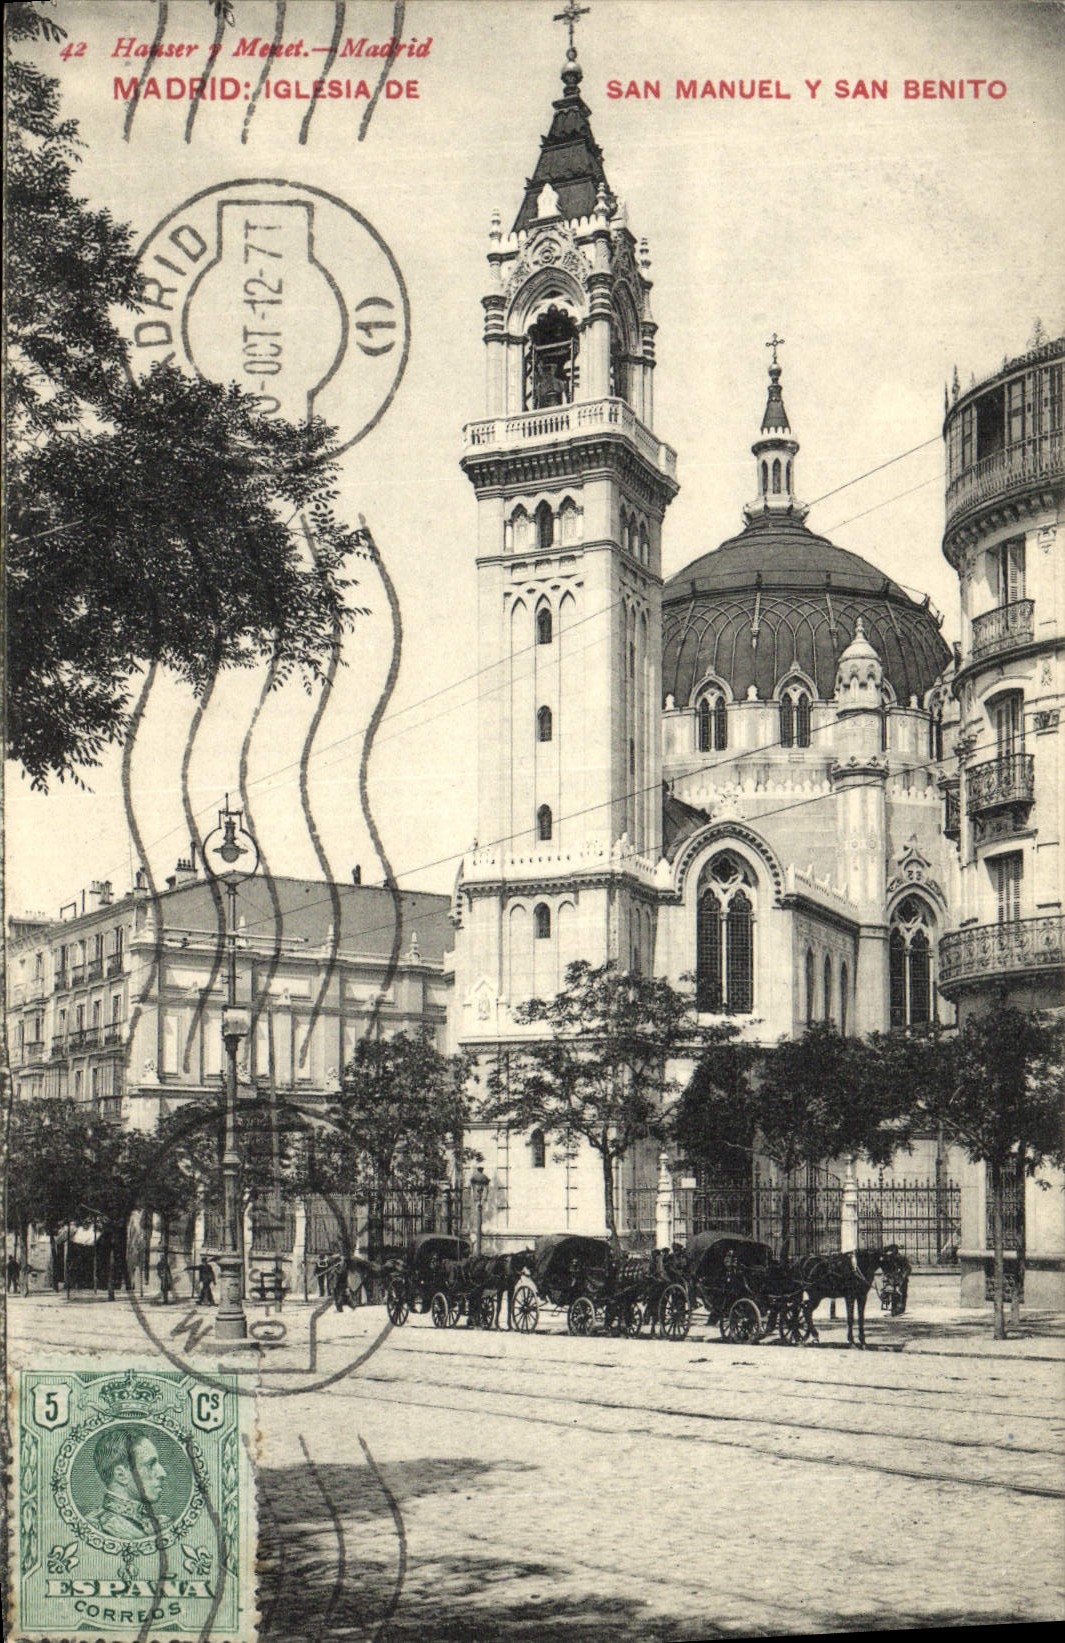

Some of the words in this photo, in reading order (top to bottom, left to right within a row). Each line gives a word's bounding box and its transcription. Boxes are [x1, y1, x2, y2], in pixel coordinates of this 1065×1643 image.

[45, 1391, 60, 1422] 5
[45, 1572, 216, 1599] ESPAÑA
[74, 1600, 182, 1623] CORREOS
